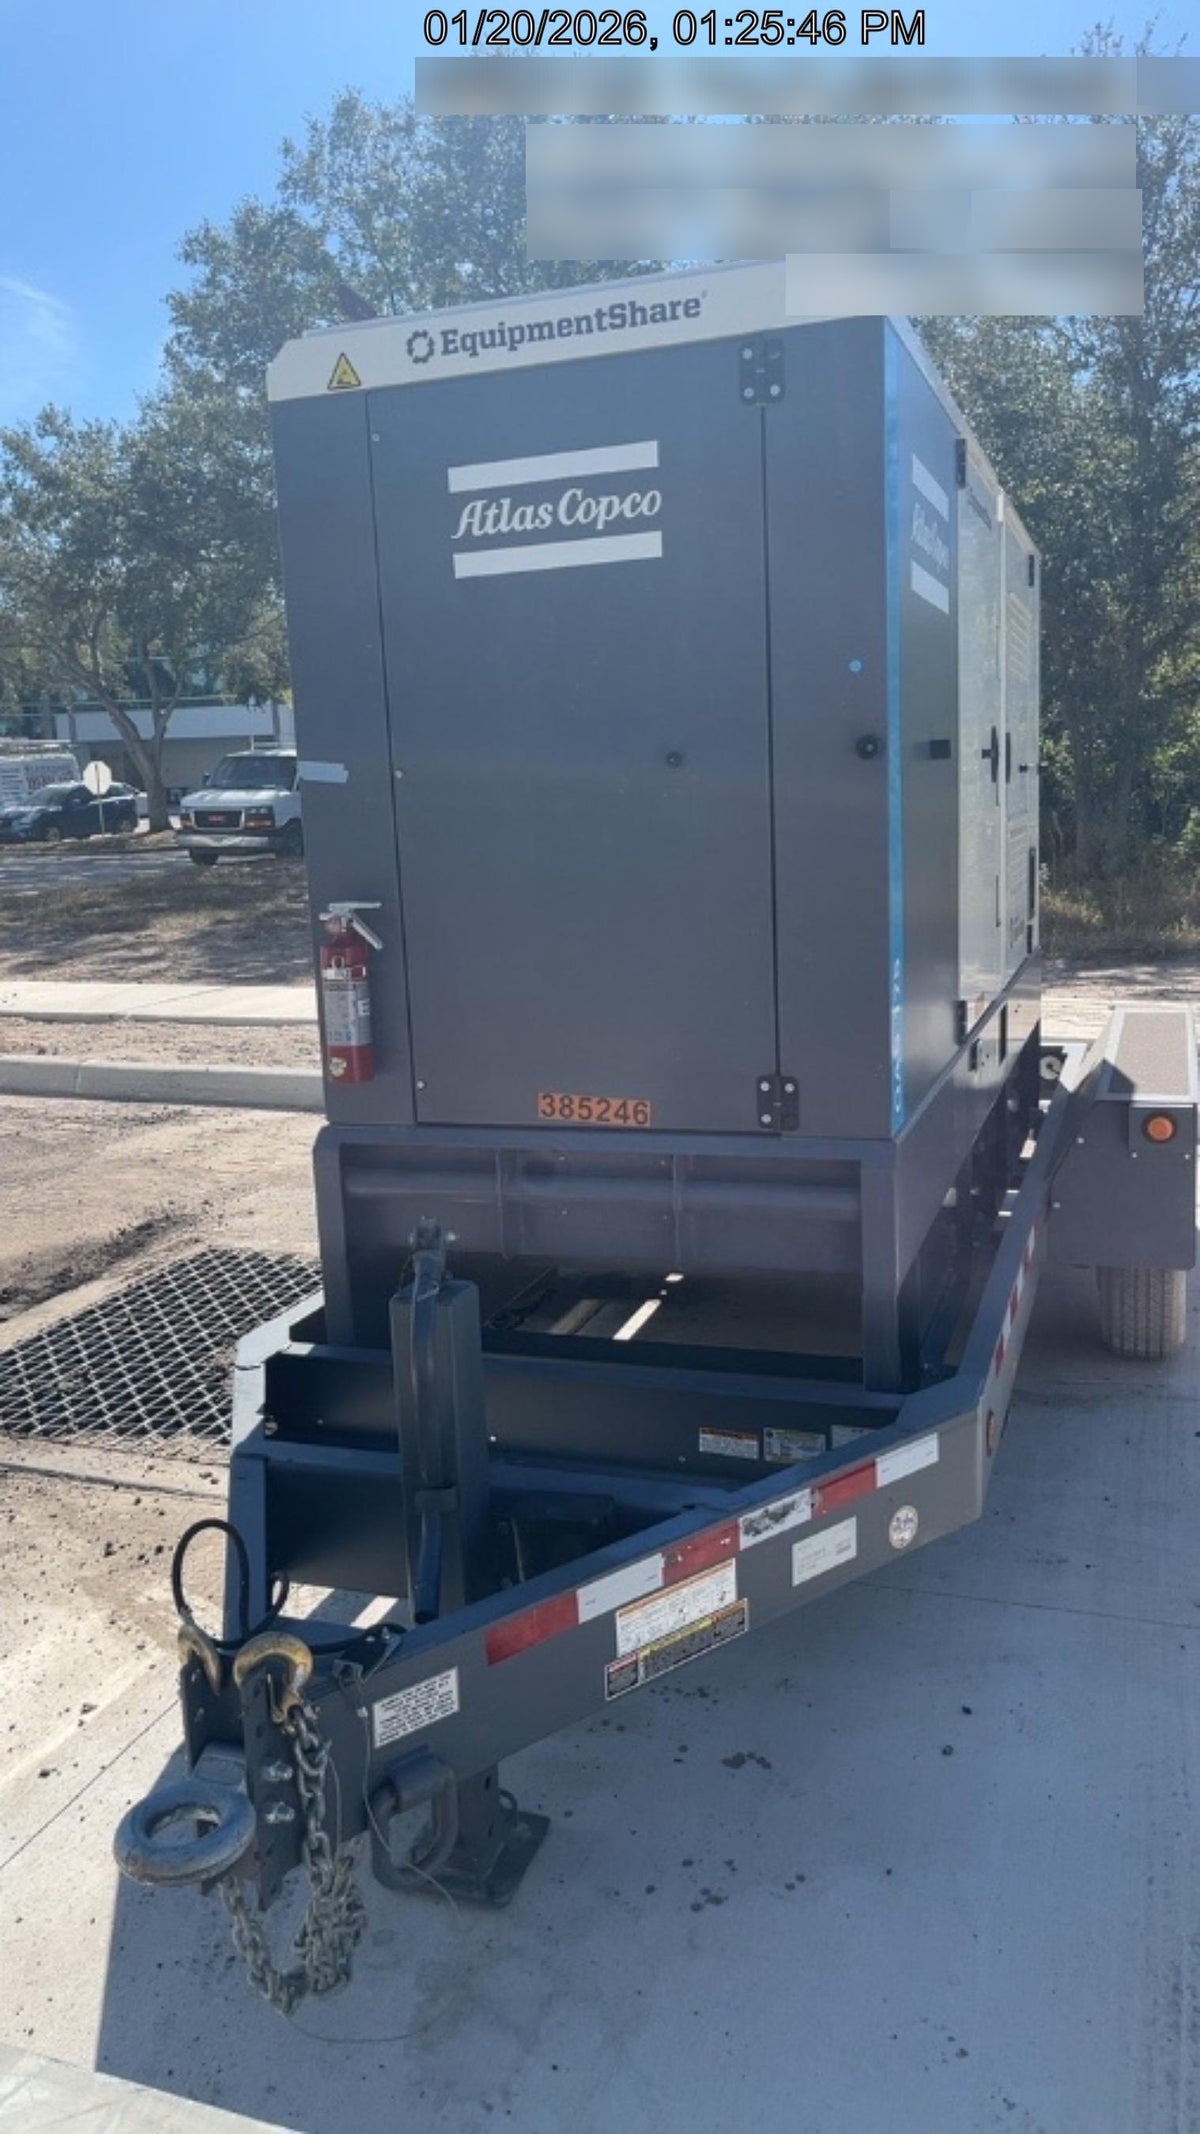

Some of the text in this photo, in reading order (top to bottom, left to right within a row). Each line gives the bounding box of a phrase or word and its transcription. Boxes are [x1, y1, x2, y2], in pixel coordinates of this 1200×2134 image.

[440, 297, 701, 358] EquipmentShare
[451, 488, 662, 540] Atlas Copco
[541, 1093, 649, 1125] 385246
